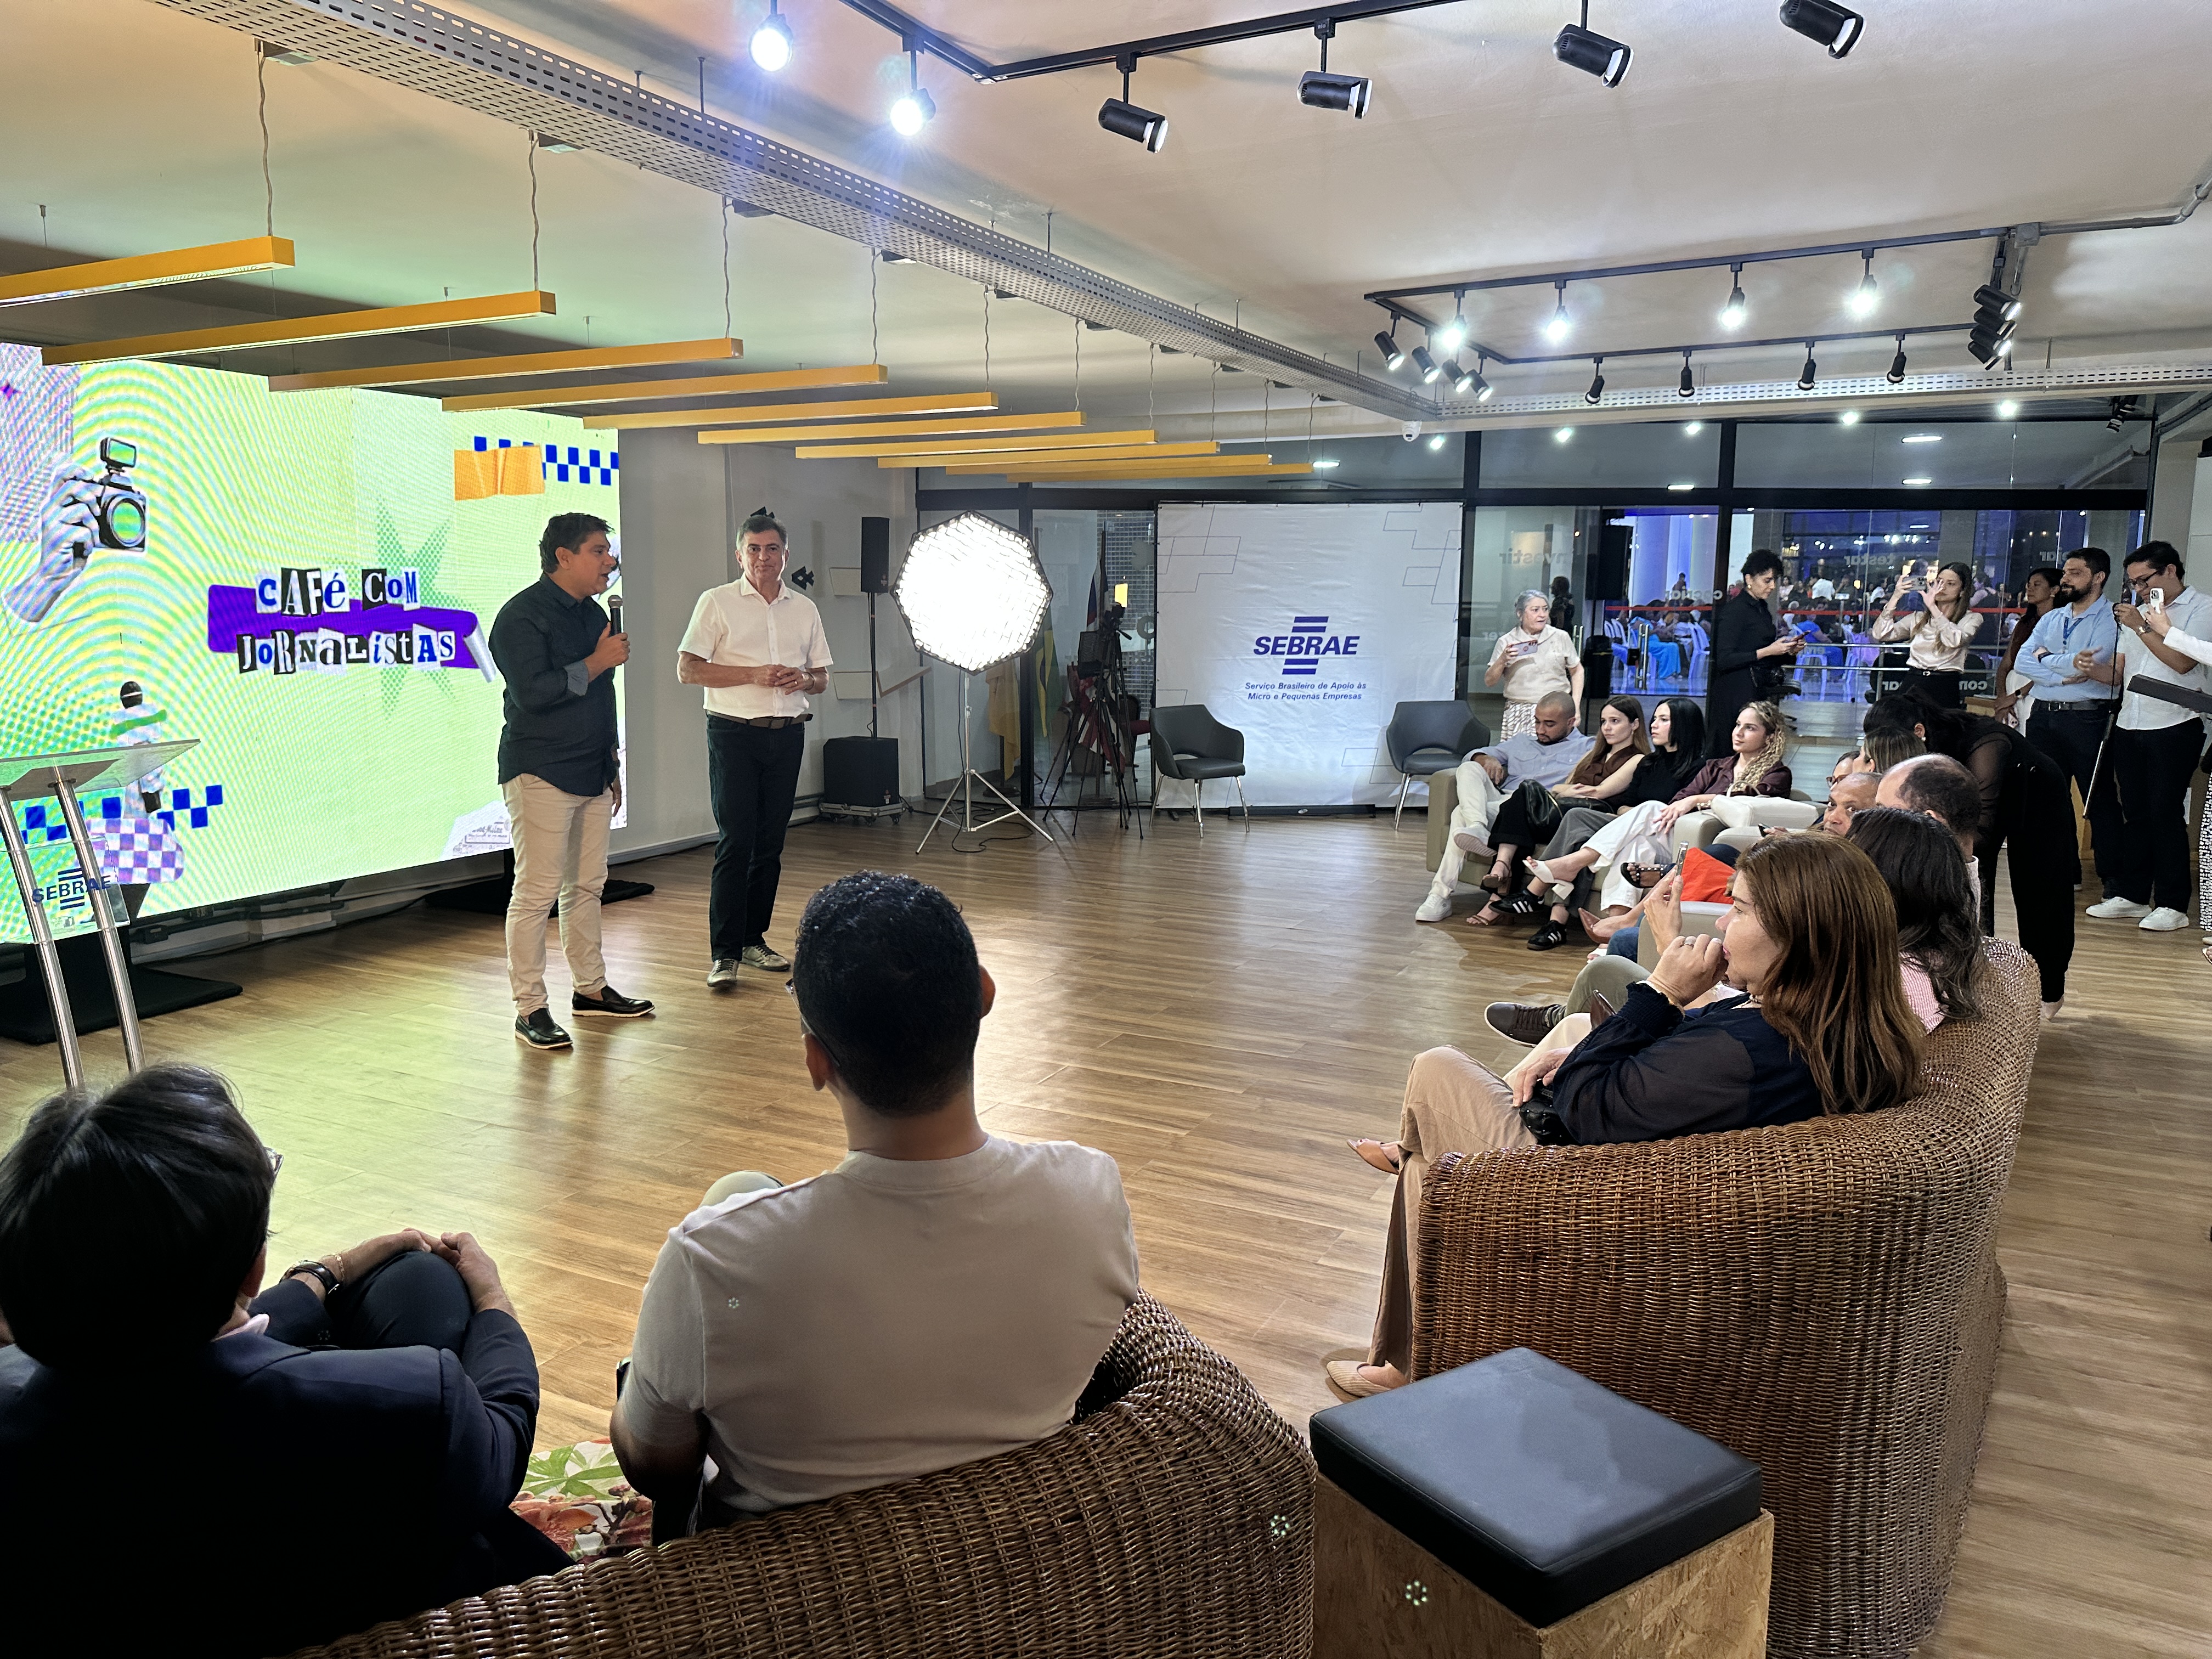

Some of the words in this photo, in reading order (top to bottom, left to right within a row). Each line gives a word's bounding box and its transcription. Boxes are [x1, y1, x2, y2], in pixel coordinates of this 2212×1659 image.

[1254, 636, 1360, 655] SEBRAE
[1245, 682, 1276, 691] Serviço
[1330, 682, 1355, 691] Apoio
[1281, 692, 1321, 701] Pequenas
[1323, 692, 1362, 701] Empresas
[32, 875, 111, 903] SEBRAE
